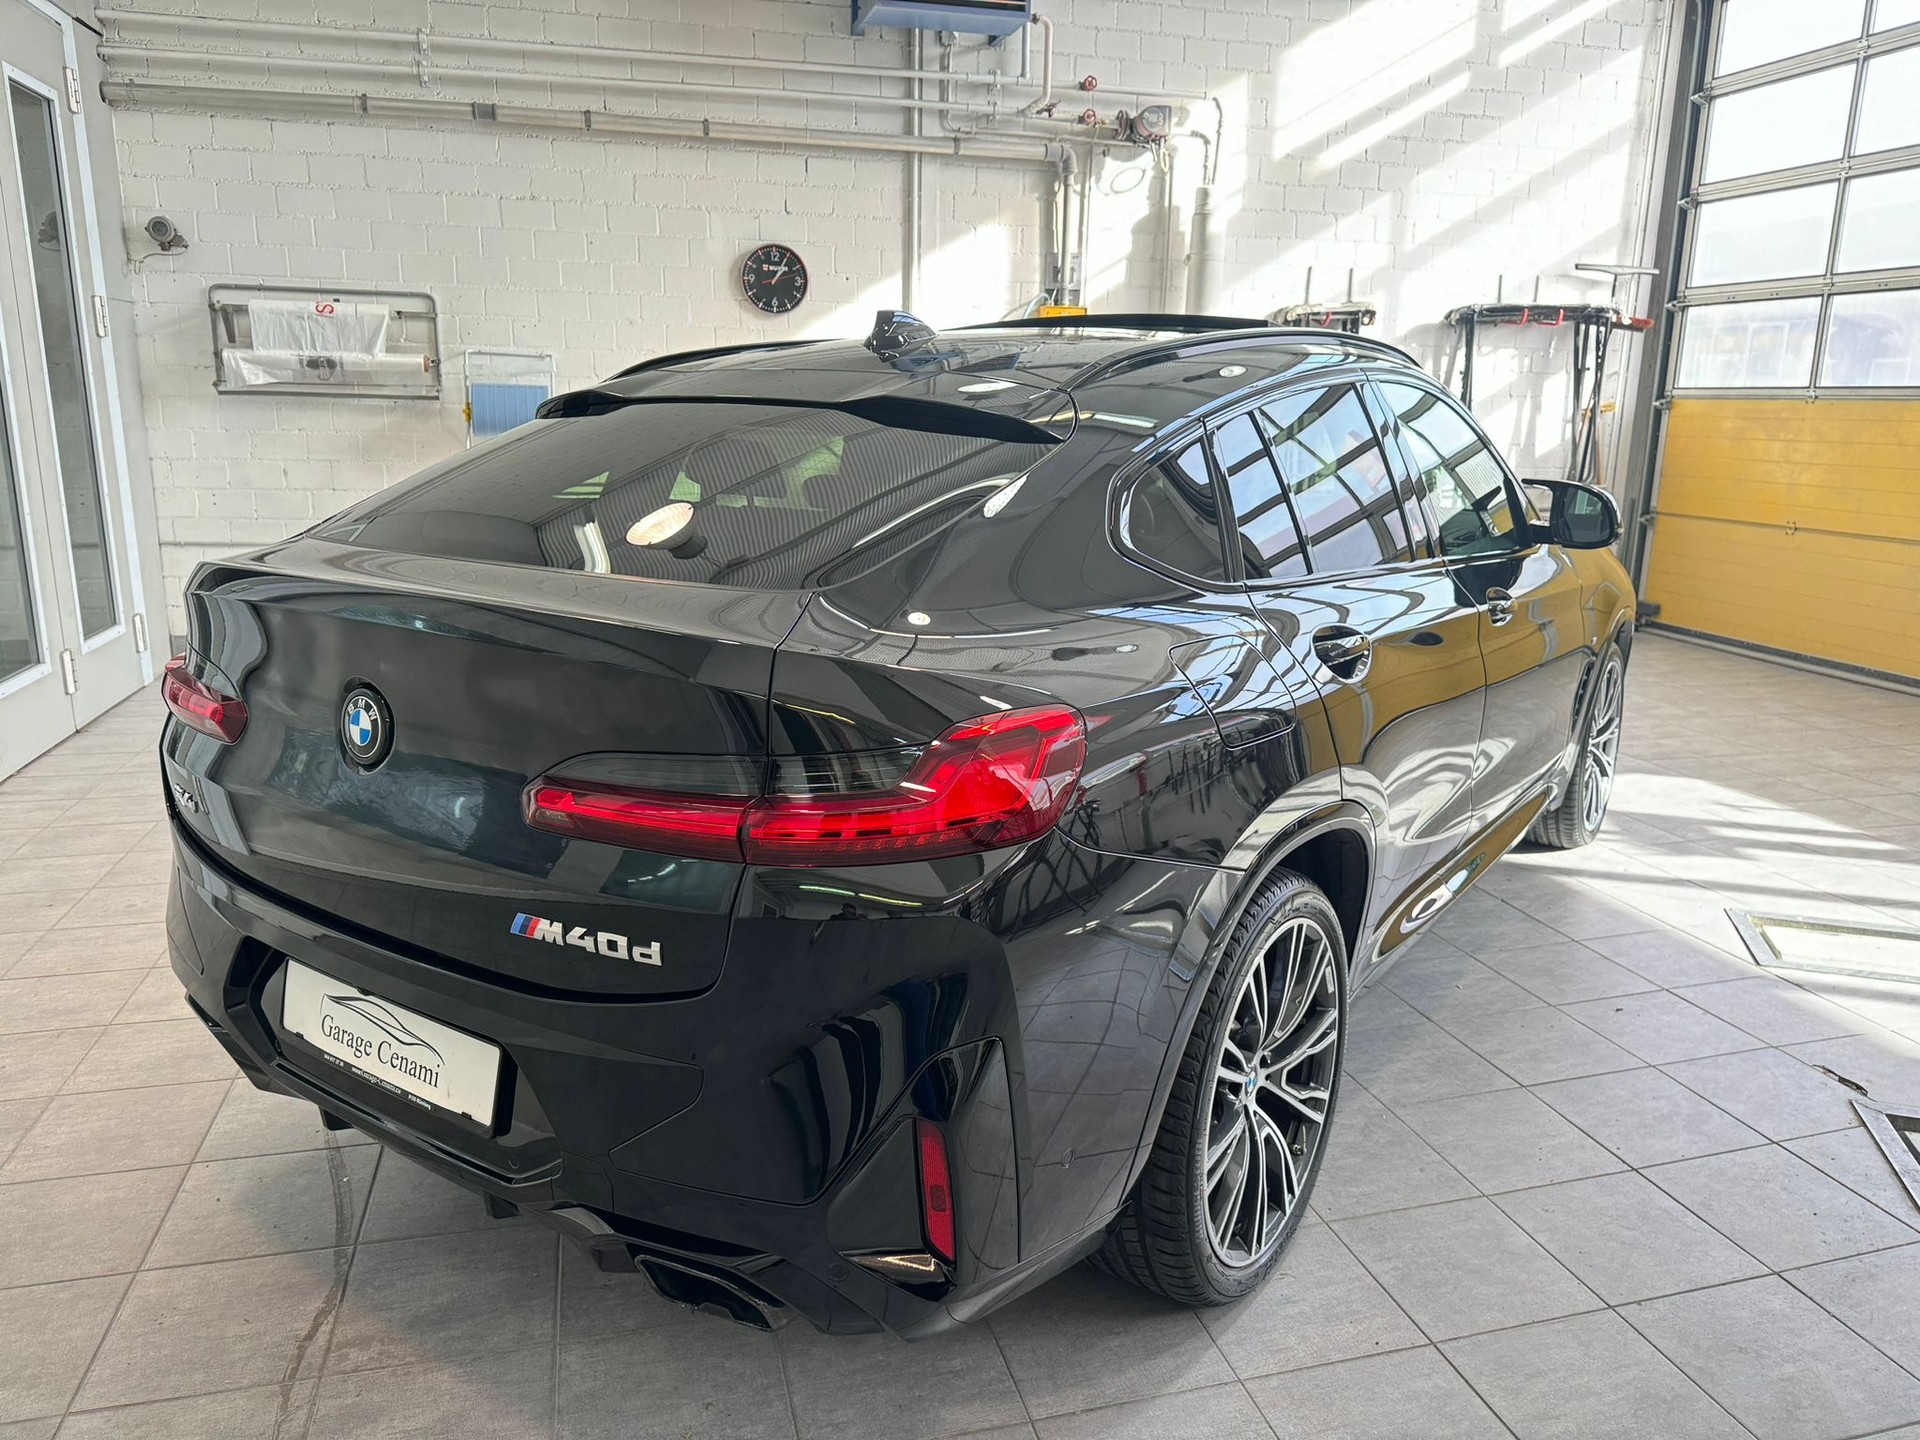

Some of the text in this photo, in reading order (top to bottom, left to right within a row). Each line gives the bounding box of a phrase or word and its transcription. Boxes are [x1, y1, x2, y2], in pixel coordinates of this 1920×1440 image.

[770, 252, 780, 261] 12
[748, 274, 755, 283] 9
[794, 277, 801, 286] 3
[771, 297, 778, 306] 6
[347, 698, 377, 721] BMW
[533, 916, 662, 966] M40d
[321, 1014, 440, 1089] Garage Cenami
